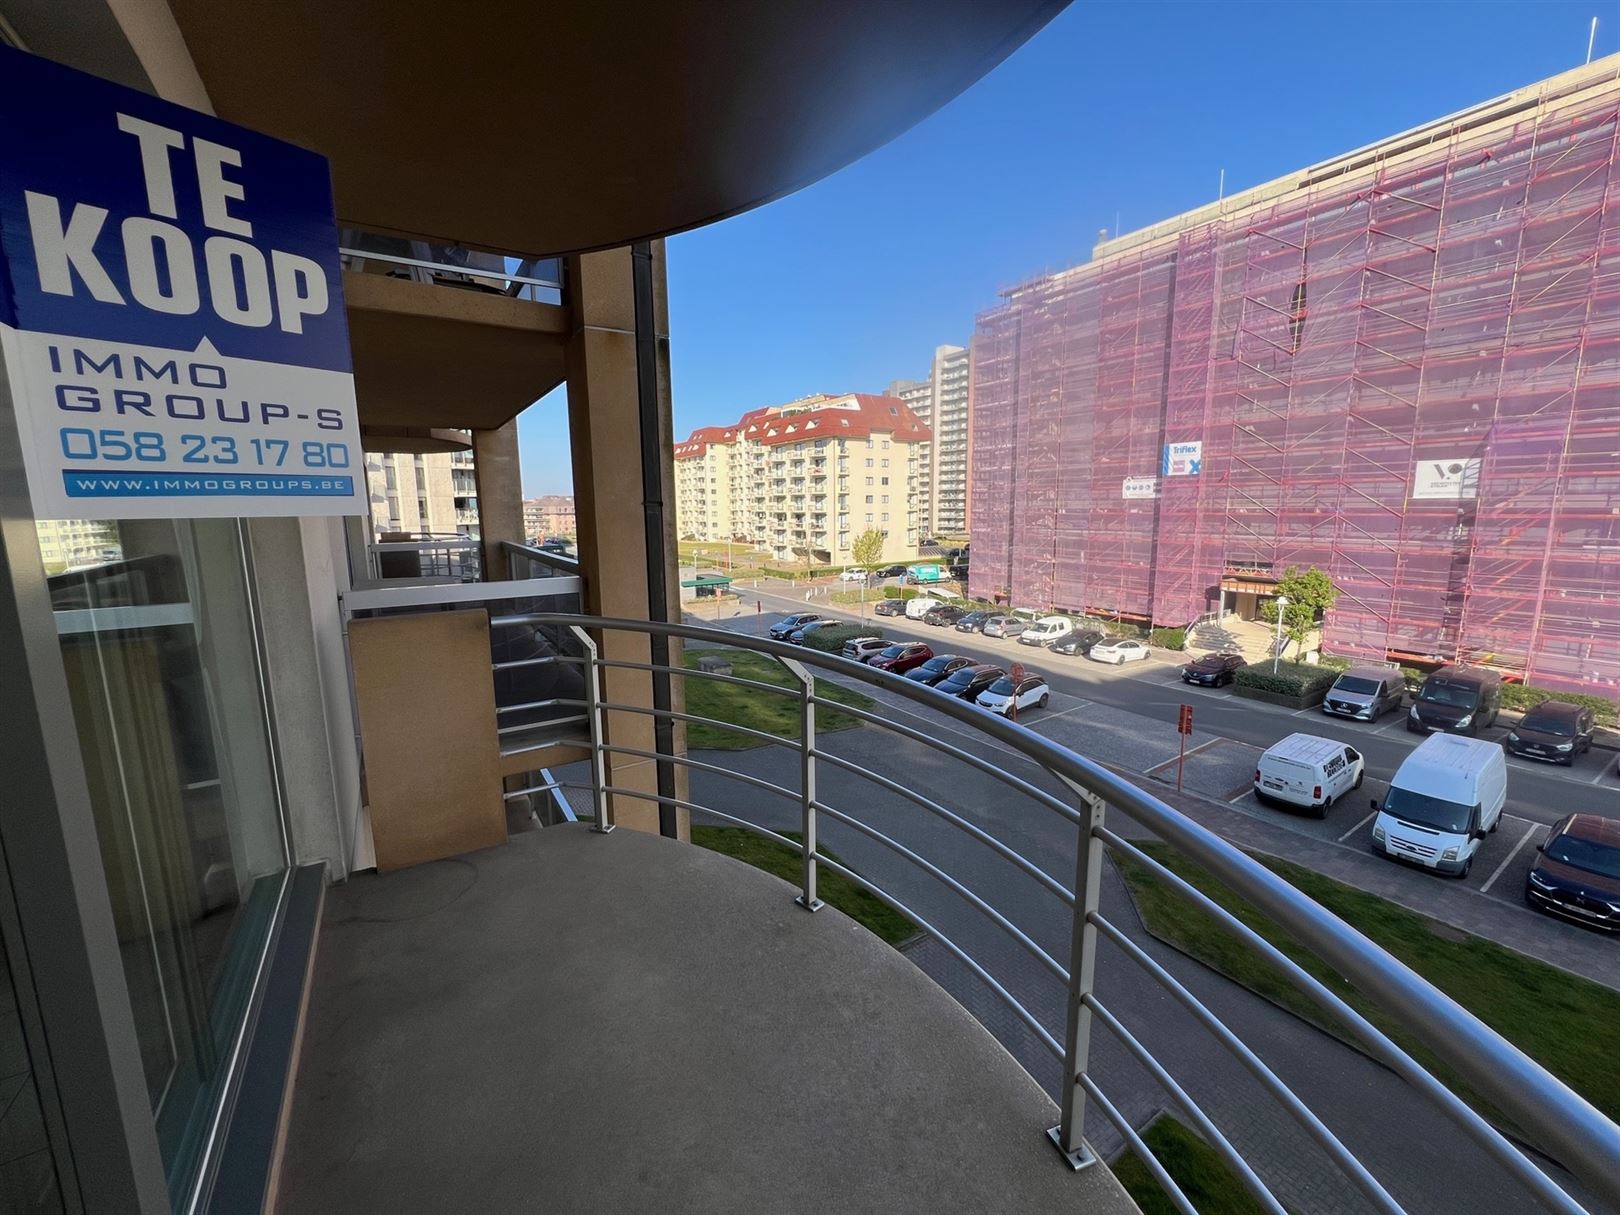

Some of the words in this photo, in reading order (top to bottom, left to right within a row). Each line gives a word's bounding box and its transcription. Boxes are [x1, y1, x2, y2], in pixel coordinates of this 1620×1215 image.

[116, 112, 253, 238] TE
[24, 190, 328, 334] KOOP
[49, 346, 227, 389] IMMO
[55, 385, 343, 430] GROUP-S
[59, 428, 166, 462] 058
[181, 434, 239, 464] 23
[251, 439, 289, 466] 17
[302, 442, 349, 468] 80
[1173, 446, 1197, 454] Triflex
[77, 480, 345, 490] WWW.IMMOGROUPS.BE
